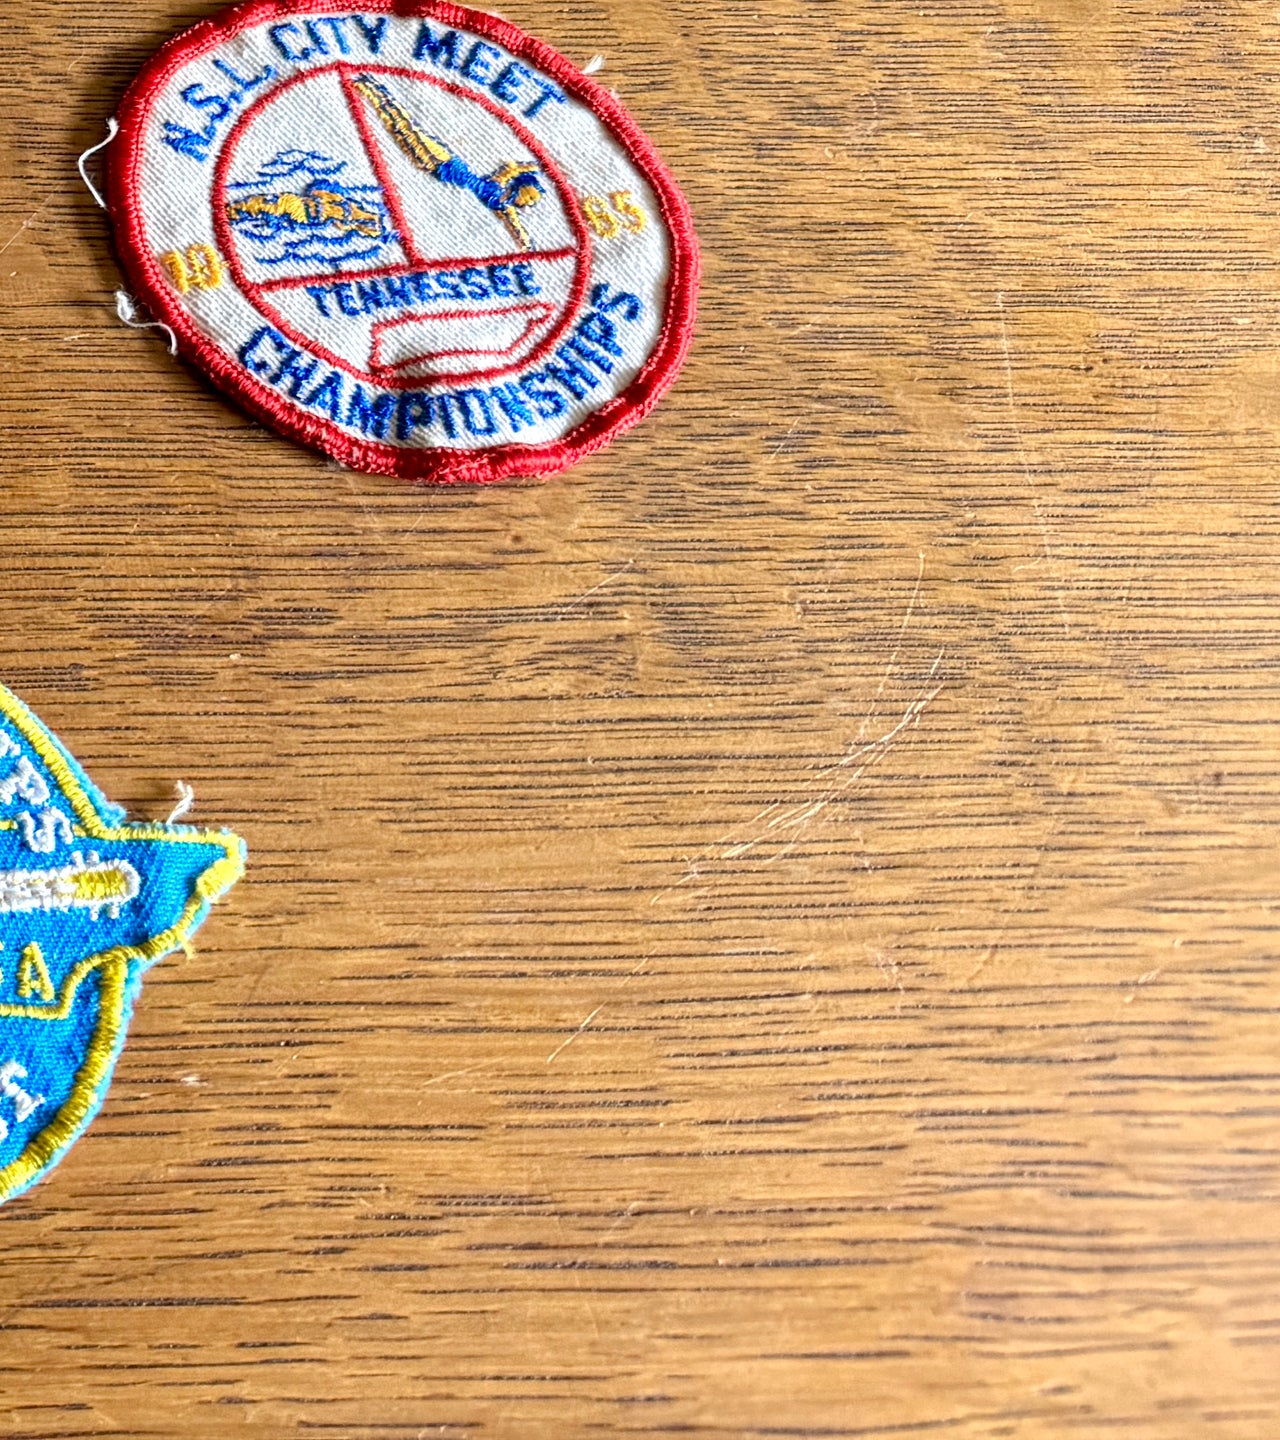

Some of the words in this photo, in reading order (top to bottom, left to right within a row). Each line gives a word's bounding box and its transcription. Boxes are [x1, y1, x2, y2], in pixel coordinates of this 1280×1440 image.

[268, 14, 389, 63] CITY
[412, 19, 567, 119] MEET
[160, 242, 223, 295] 19
[309, 261, 542, 318] TENNESSEE
[240, 281, 640, 441] CHAMPIONSHIPS
